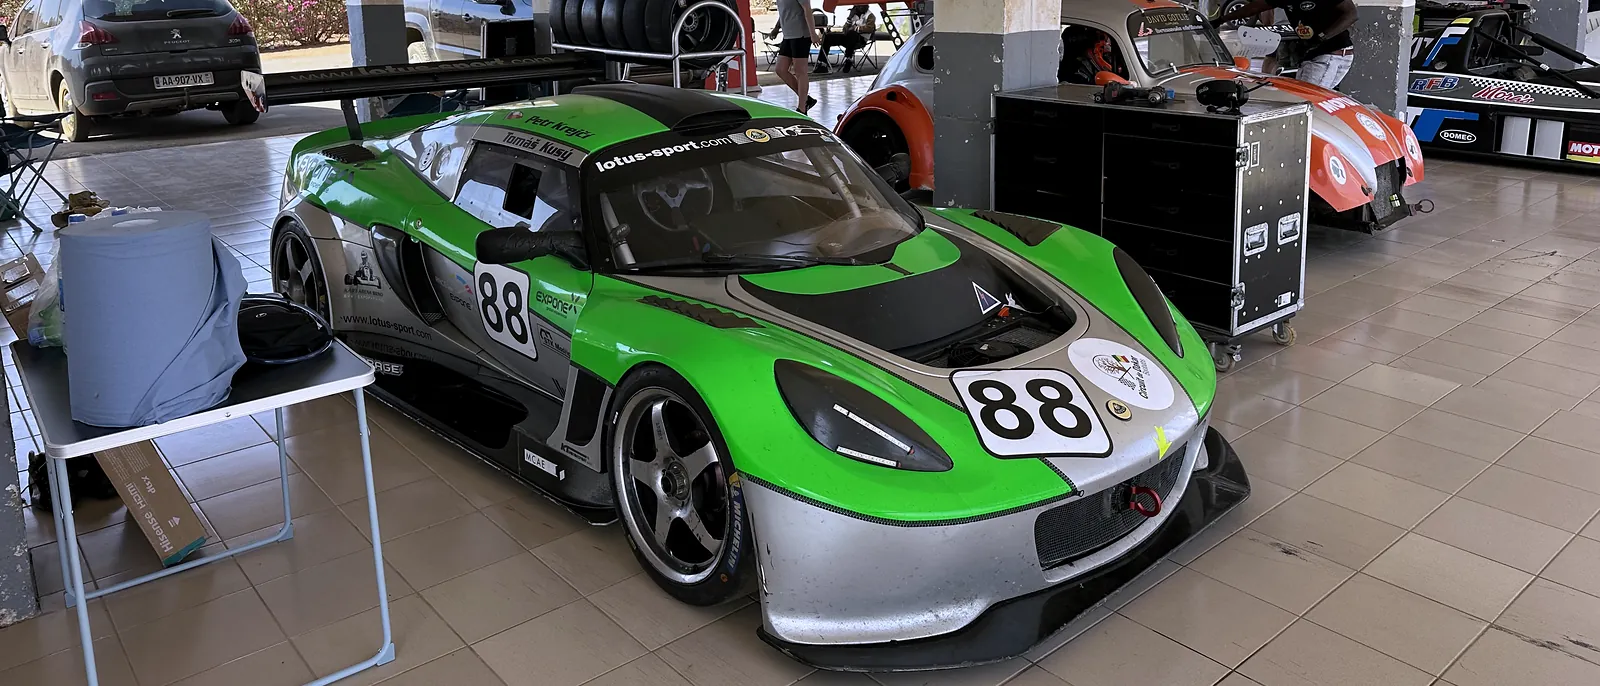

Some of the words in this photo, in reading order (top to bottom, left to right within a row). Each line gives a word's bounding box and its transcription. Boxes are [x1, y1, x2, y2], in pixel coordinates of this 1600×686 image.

[1146, 14, 1167, 24] DAVID
[162, 74, 203, 86] AA-907-VX
[1411, 75, 1460, 91] RFB
[525, 115, 554, 127] Petr
[551, 121, 596, 140] Krejčí
[1443, 131, 1473, 142] DOMEC
[503, 131, 540, 150] Tomáš
[539, 141, 574, 162] Kusý
[595, 135, 733, 173] lotus-sport.com
[479, 272, 529, 345] 88
[343, 315, 433, 342] www.lotus-sport.com
[968, 378, 1092, 440] 88
[526, 452, 546, 470] MCAE
[144, 510, 174, 553] Hisense
[727, 500, 742, 569] MICHELIN
